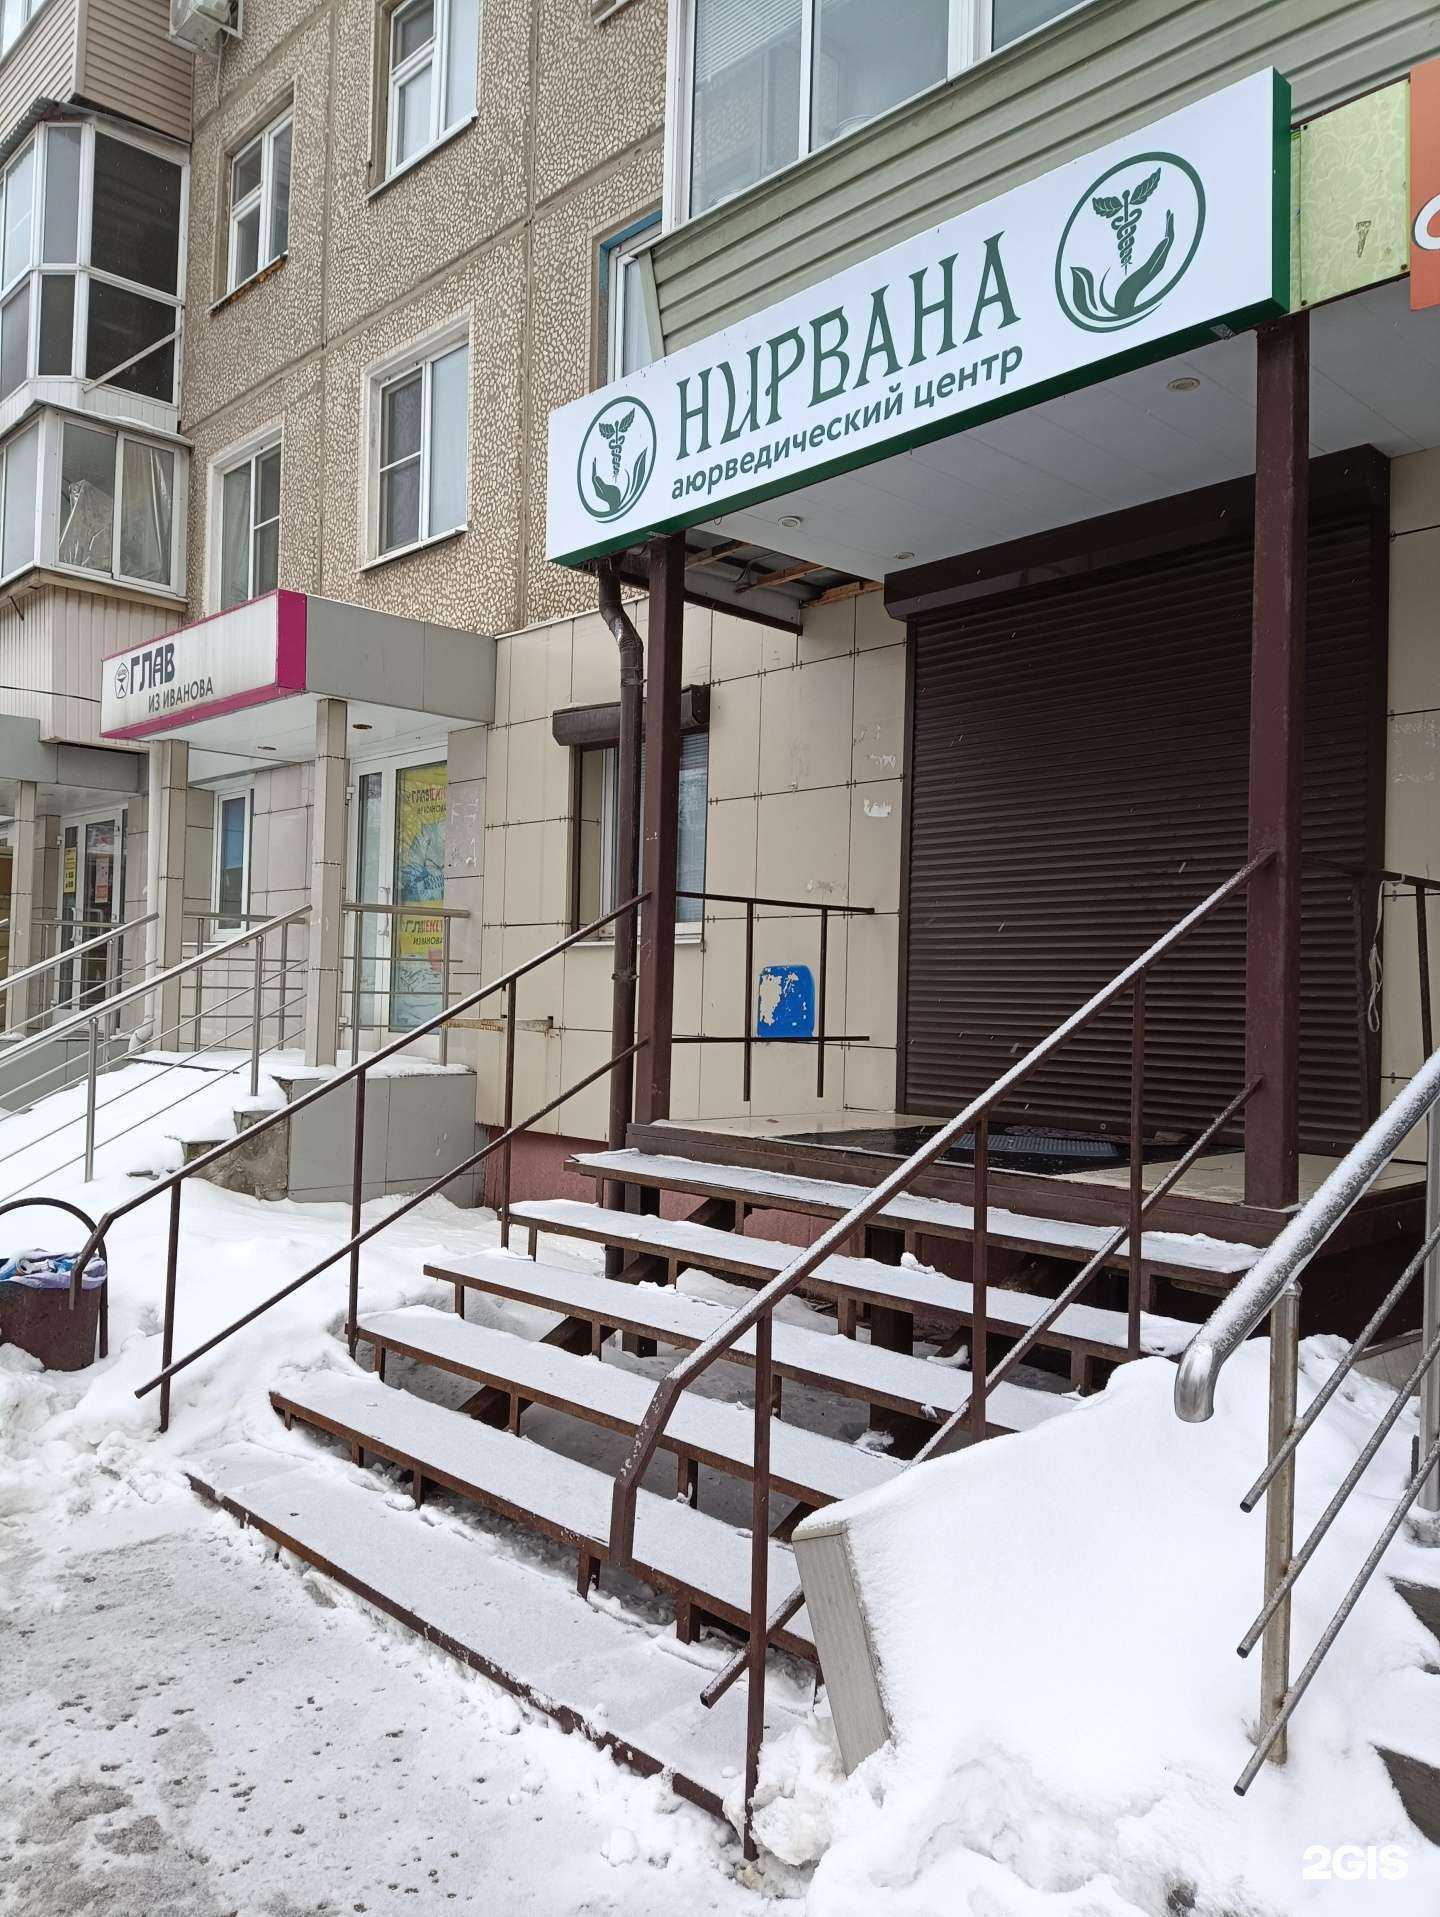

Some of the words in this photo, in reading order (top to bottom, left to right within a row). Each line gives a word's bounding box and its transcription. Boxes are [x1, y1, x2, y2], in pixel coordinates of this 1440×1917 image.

[676, 230, 1022, 461] НИРВАНА
[671, 382, 904, 500] аюрведический
[914, 345, 1023, 409] центр
[129, 642, 176, 695] ГЛАВ
[148, 692, 161, 713] ИЗ
[162, 676, 214, 710] ИВАНОВА
